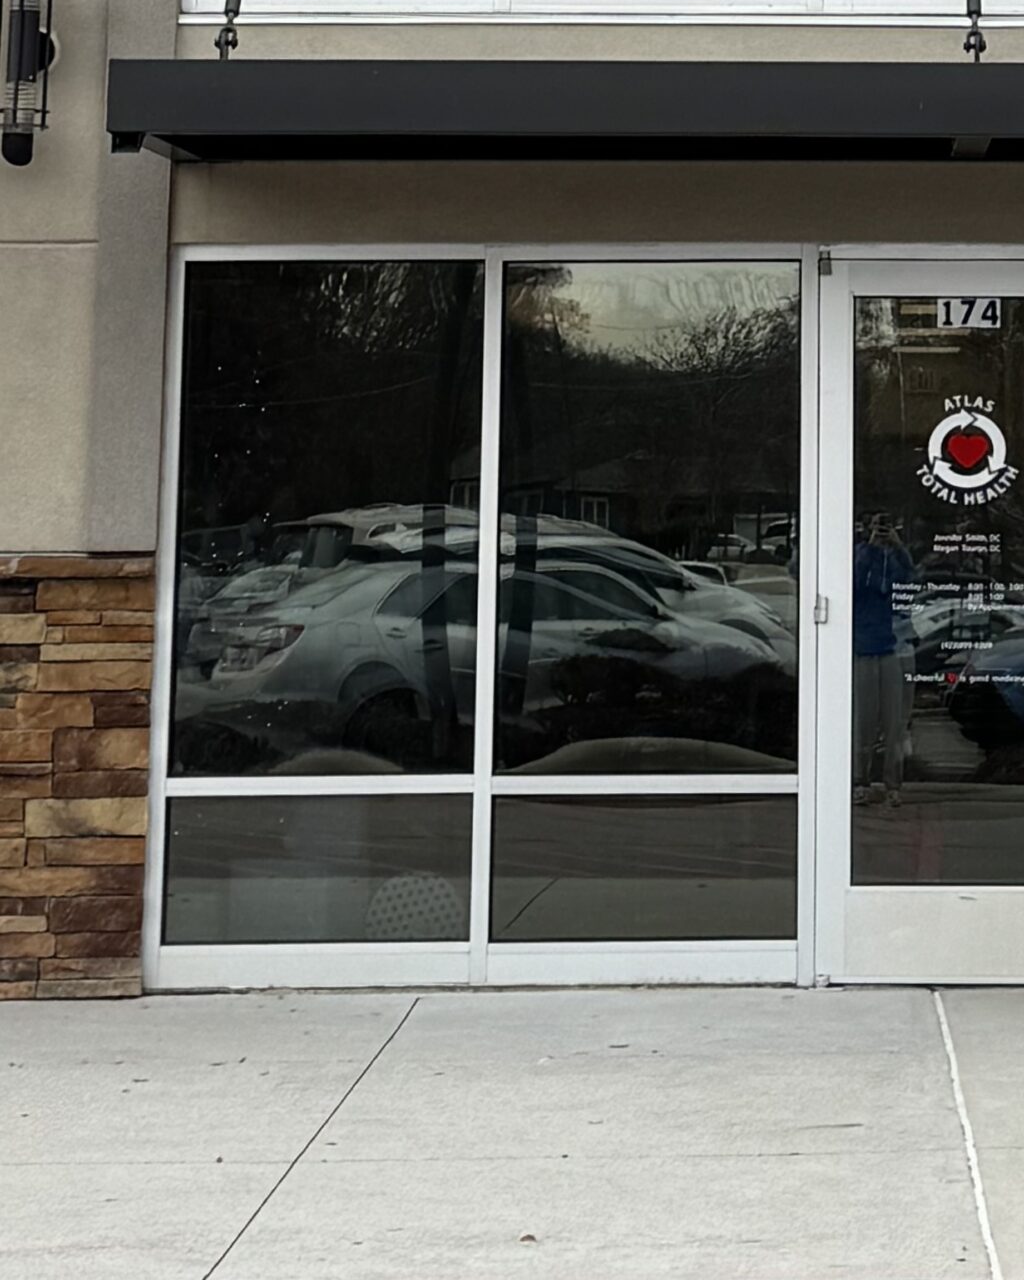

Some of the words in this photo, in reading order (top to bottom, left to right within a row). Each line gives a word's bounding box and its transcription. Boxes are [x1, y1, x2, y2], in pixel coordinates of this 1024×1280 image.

[942, 298, 999, 326] 174
[944, 394, 995, 412] ATLAS
[916, 464, 958, 505] TOTAL
[963, 465, 1020, 505] HEALTH
[892, 582, 921, 592] Monday
[927, 582, 961, 592] Thursday
[892, 592, 914, 603] Friday
